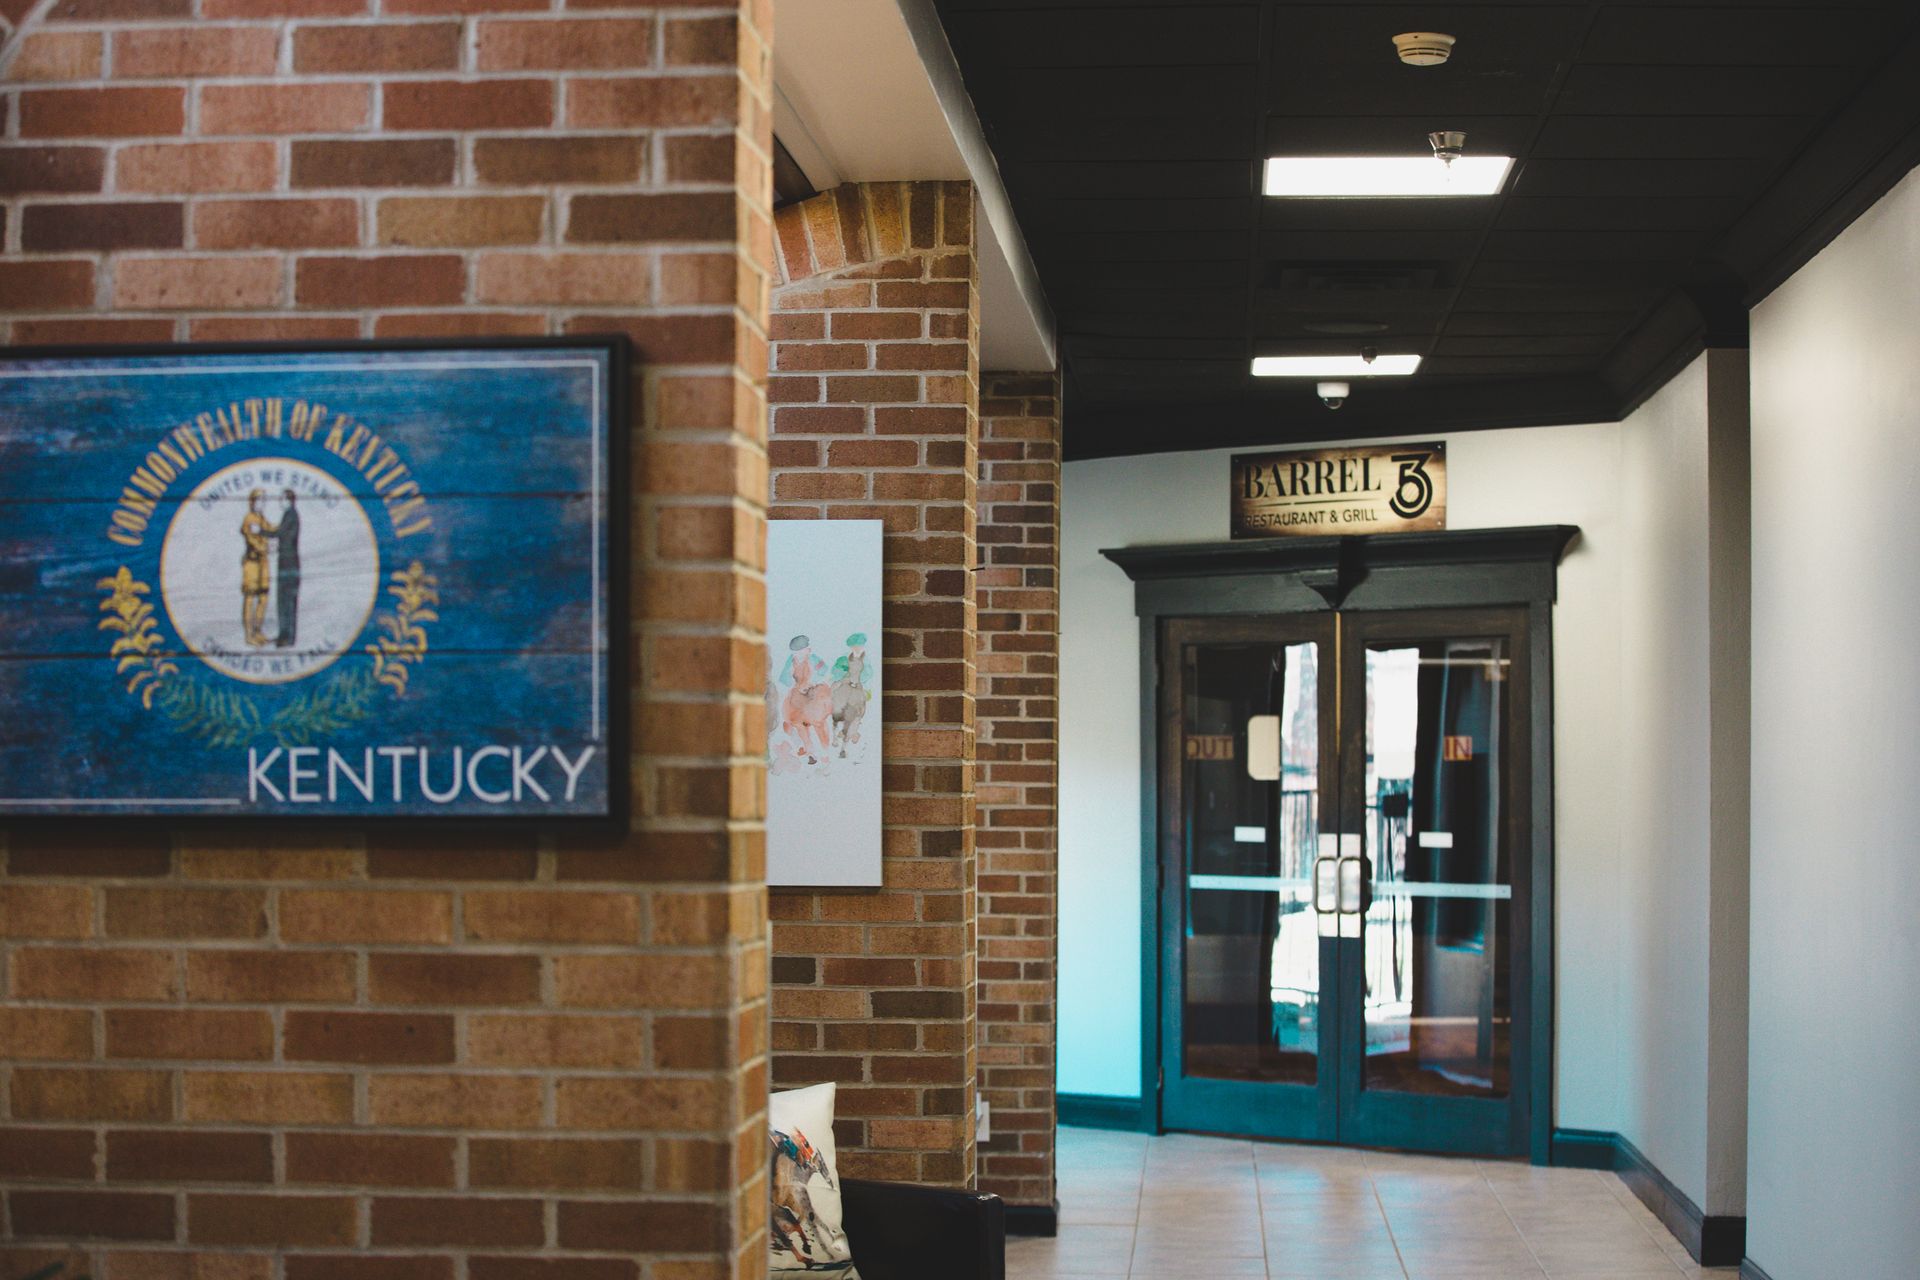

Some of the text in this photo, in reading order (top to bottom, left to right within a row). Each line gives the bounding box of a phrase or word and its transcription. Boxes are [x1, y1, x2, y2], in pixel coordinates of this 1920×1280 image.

[107, 397, 434, 546] COMMONWEALTH OF KENTUCKY
[200, 470, 339, 510] UNITED WE STAND
[1243, 457, 1382, 499] BARREL
[1245, 508, 1378, 528] RESTAURANT & GRILL
[1185, 736, 1233, 758] OUT
[1445, 736, 1472, 761] IN
[249, 745, 596, 804] KENTUCKY
